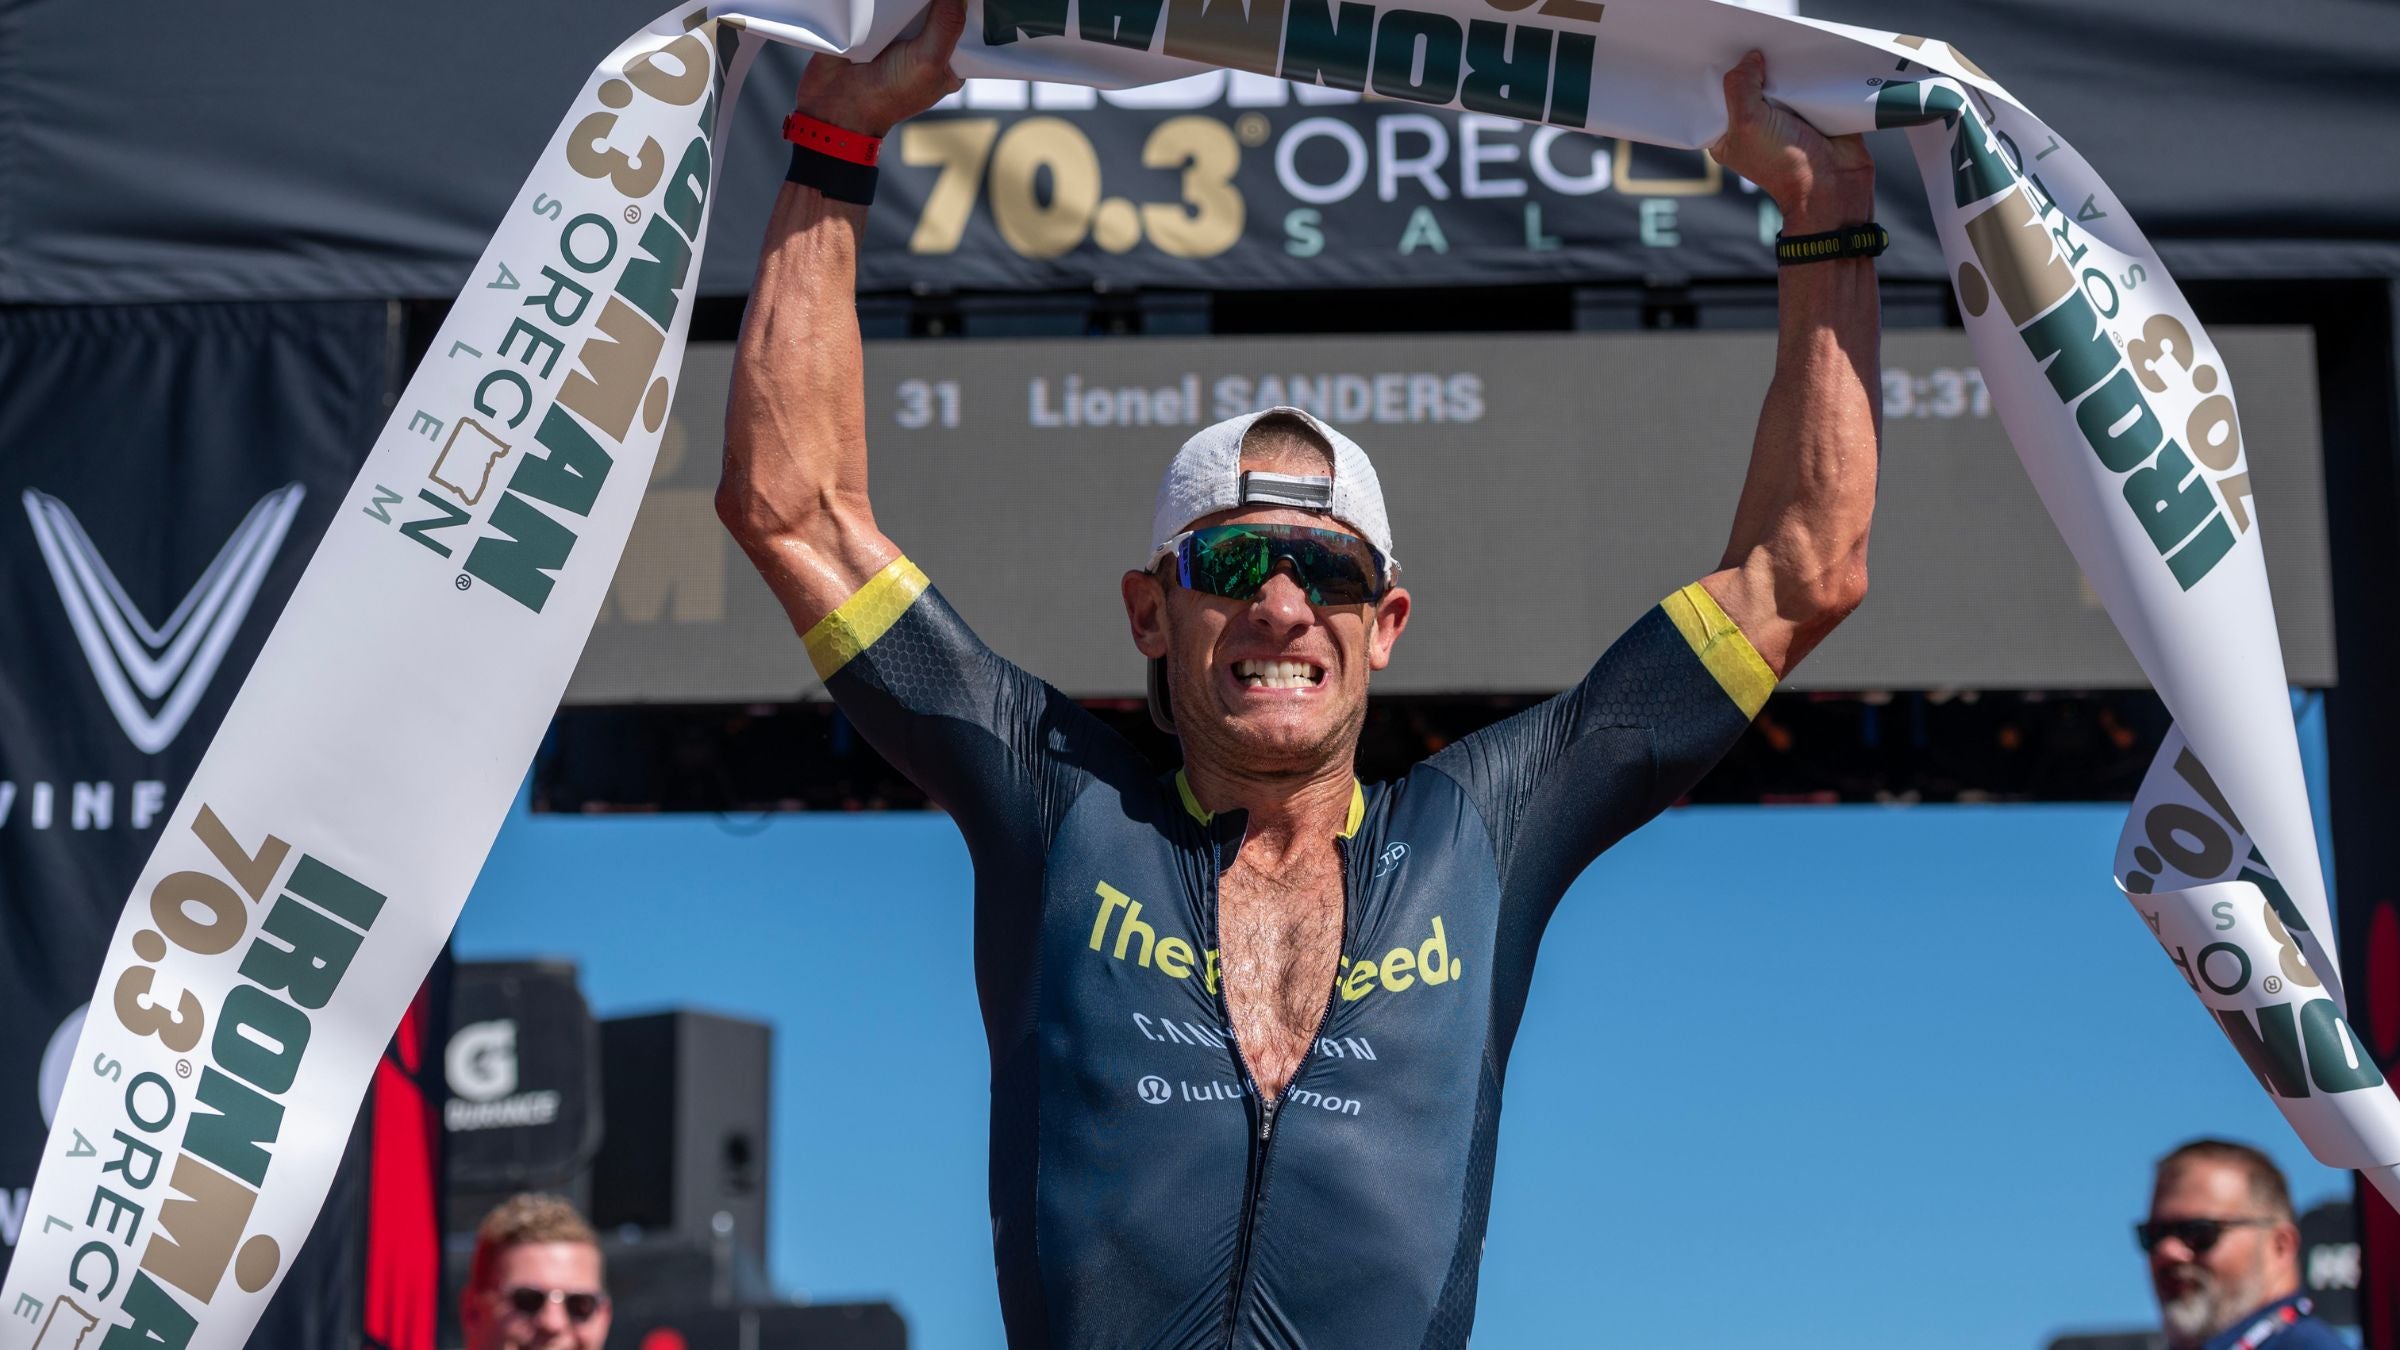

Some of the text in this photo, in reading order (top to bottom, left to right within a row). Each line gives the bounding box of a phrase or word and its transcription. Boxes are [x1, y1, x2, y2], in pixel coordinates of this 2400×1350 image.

[363, 193, 562, 525] SALEM
[895, 381, 961, 428] 31
[1030, 374, 1199, 427] Lionel
[1213, 373, 1485, 425] SANDERS
[1089, 880, 1195, 979] The
